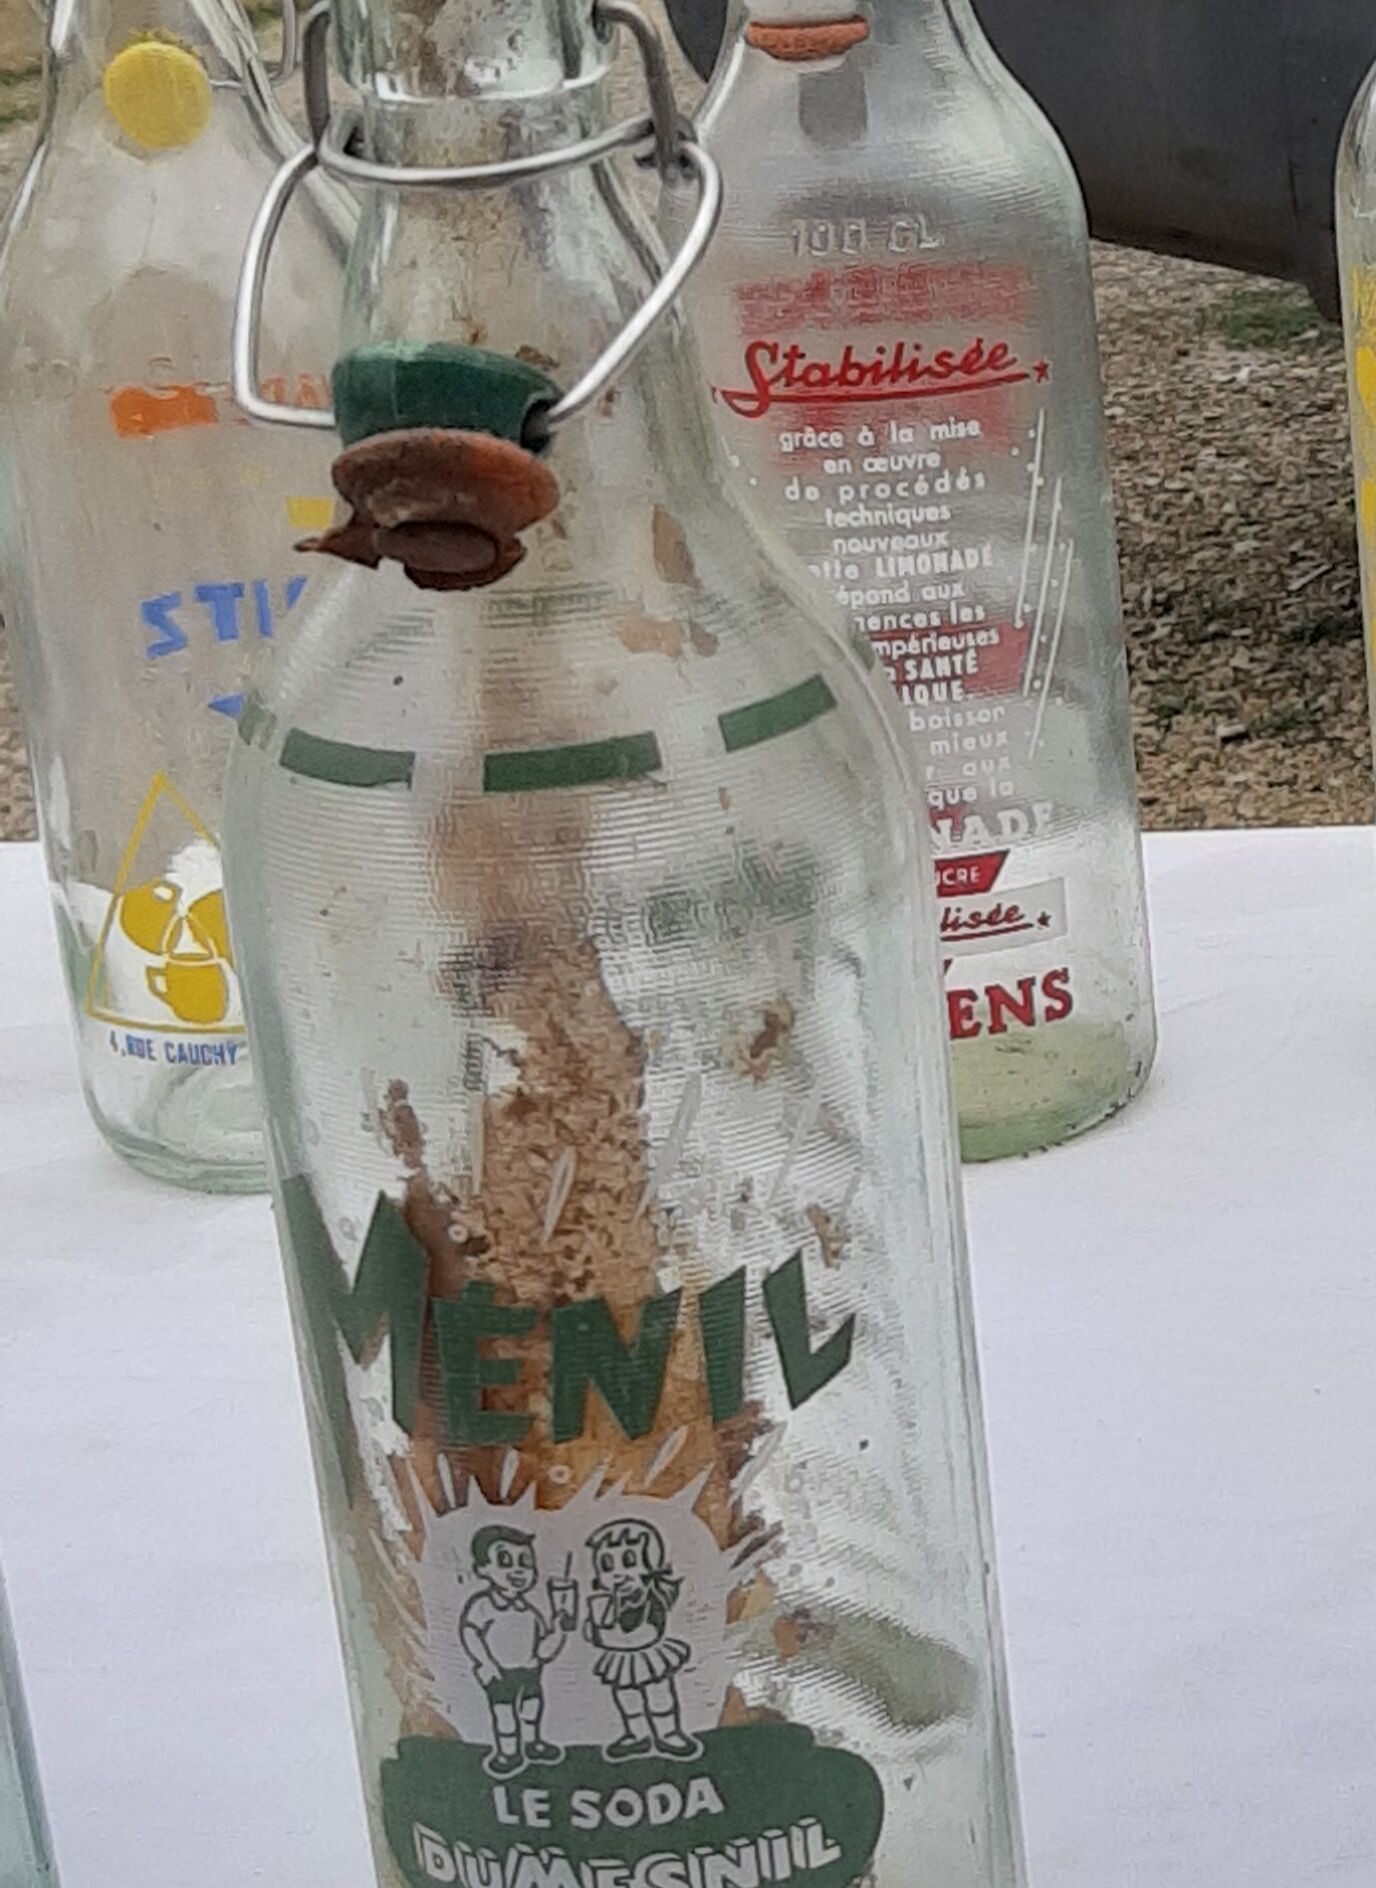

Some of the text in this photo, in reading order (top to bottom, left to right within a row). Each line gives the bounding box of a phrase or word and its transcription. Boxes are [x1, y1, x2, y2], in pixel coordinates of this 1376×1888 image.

[721, 336, 1030, 419] Stabilisée
[778, 424, 845, 453] grâce
[889, 419, 914, 444] la
[929, 415, 982, 441] mise
[822, 457, 852, 475] en
[784, 465, 987, 505] de procédés
[824, 501, 953, 529] techniques
[832, 530, 951, 556] nouveaux
[874, 544, 995, 579] LIMONADE
[836, 579, 966, 611] épond aux
[949, 600, 987, 626] les
[872, 627, 1001, 660] mpérieuses
[904, 649, 979, 683] SANTÉ
[909, 706, 1007, 733] boisson
[929, 730, 1009, 757] mieux
[962, 756, 1012, 778] aux
[989, 776, 1015, 799] la
[940, 902, 1032, 940] lisée
[164, 1039, 240, 1067] CAUCHY
[492, 1776, 726, 1830] LE SODA
